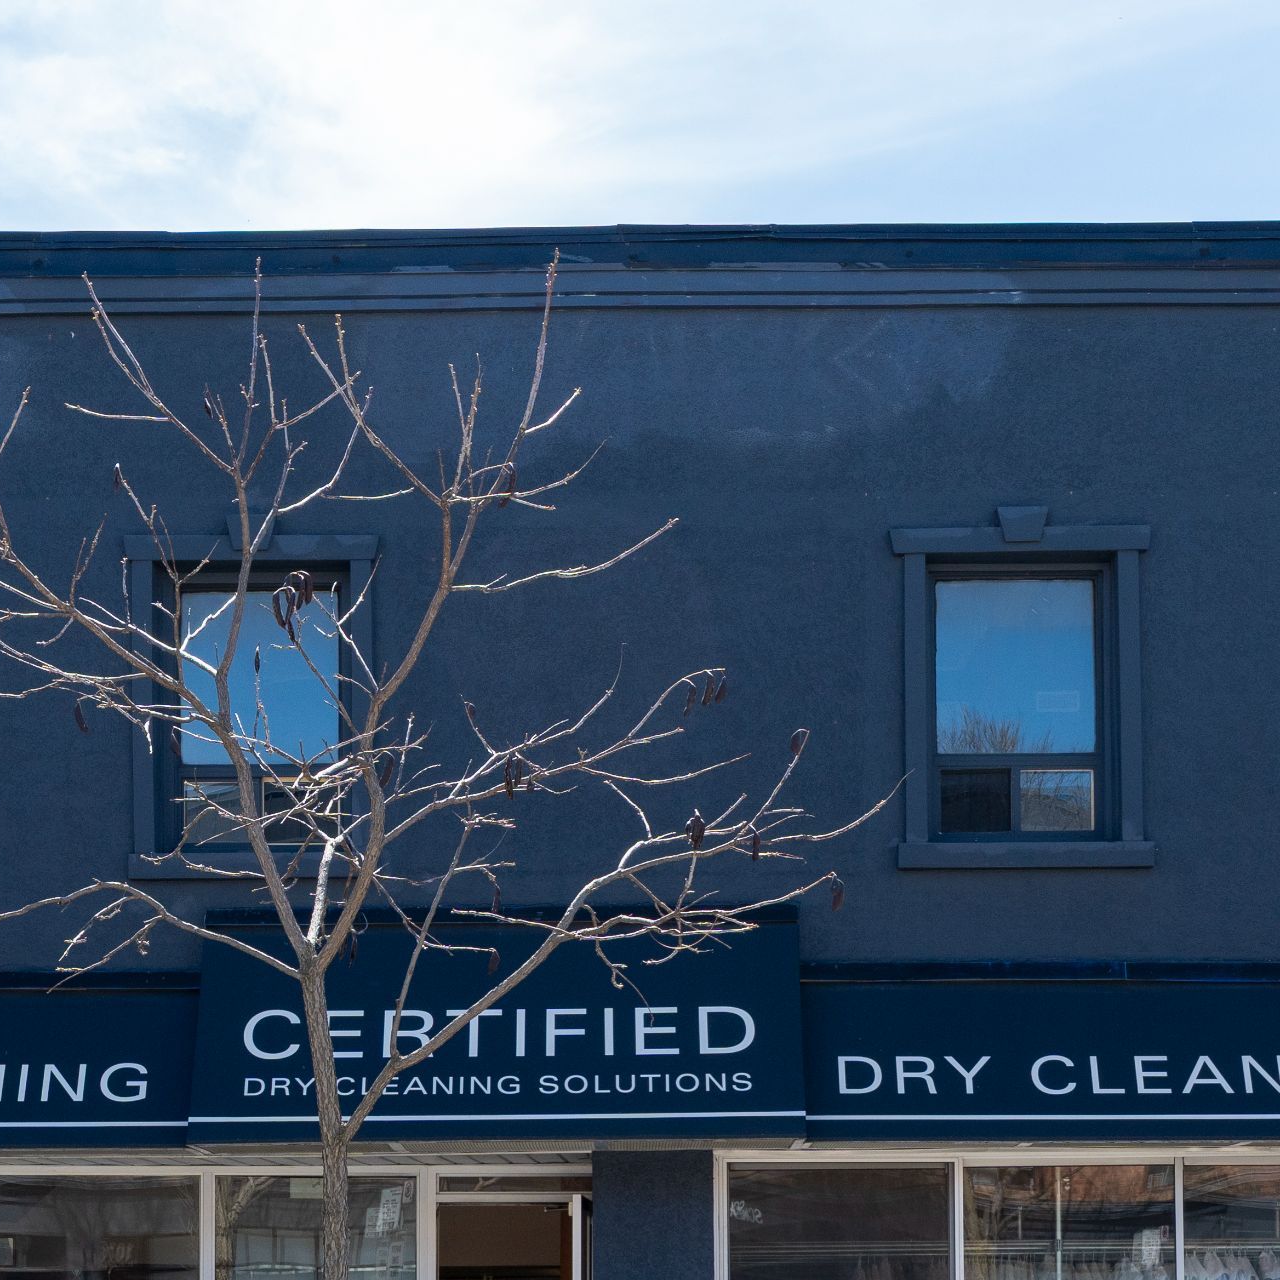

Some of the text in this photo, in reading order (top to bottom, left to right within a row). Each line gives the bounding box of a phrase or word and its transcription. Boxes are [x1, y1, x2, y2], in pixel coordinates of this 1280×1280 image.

[243, 1005, 756, 1060] CERTIFIED
[243, 1072, 753, 1097] DRY CLEANING SOLUTIONS
[837, 1055, 991, 1095] DRY
